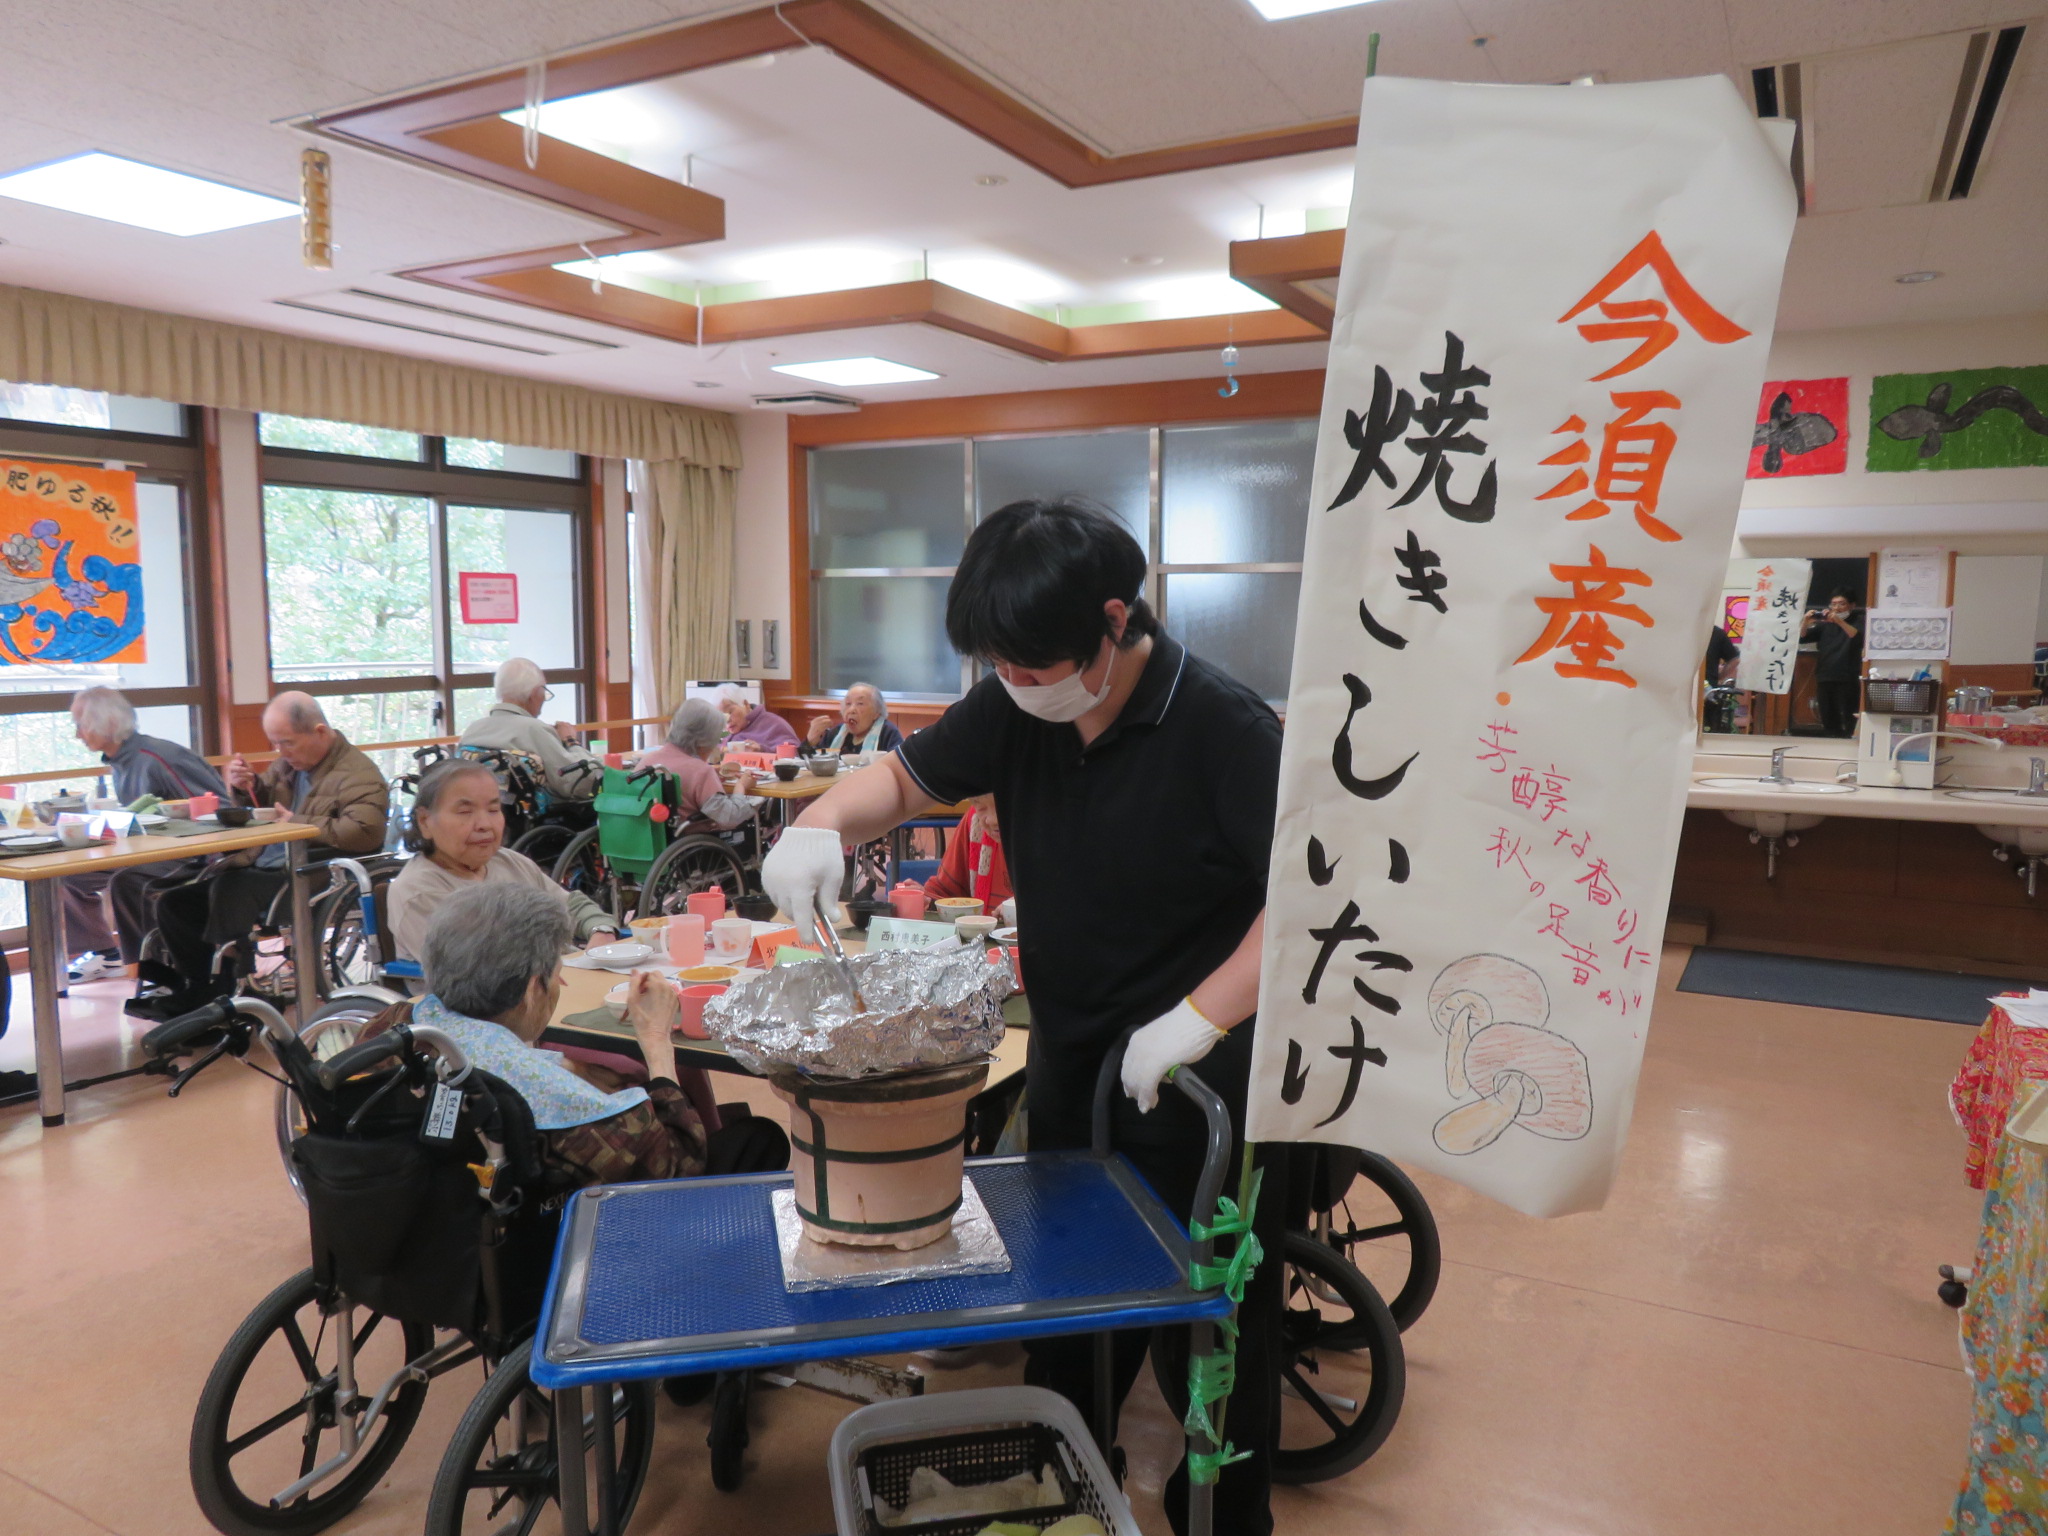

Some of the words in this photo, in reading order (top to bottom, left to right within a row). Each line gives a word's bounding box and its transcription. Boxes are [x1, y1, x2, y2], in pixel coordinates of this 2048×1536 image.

[1514, 230, 1752, 689] 今須産
[1280, 330, 1497, 1129] 焼きしいたけ
[1476, 718, 1652, 969] 芳醇な香りに
